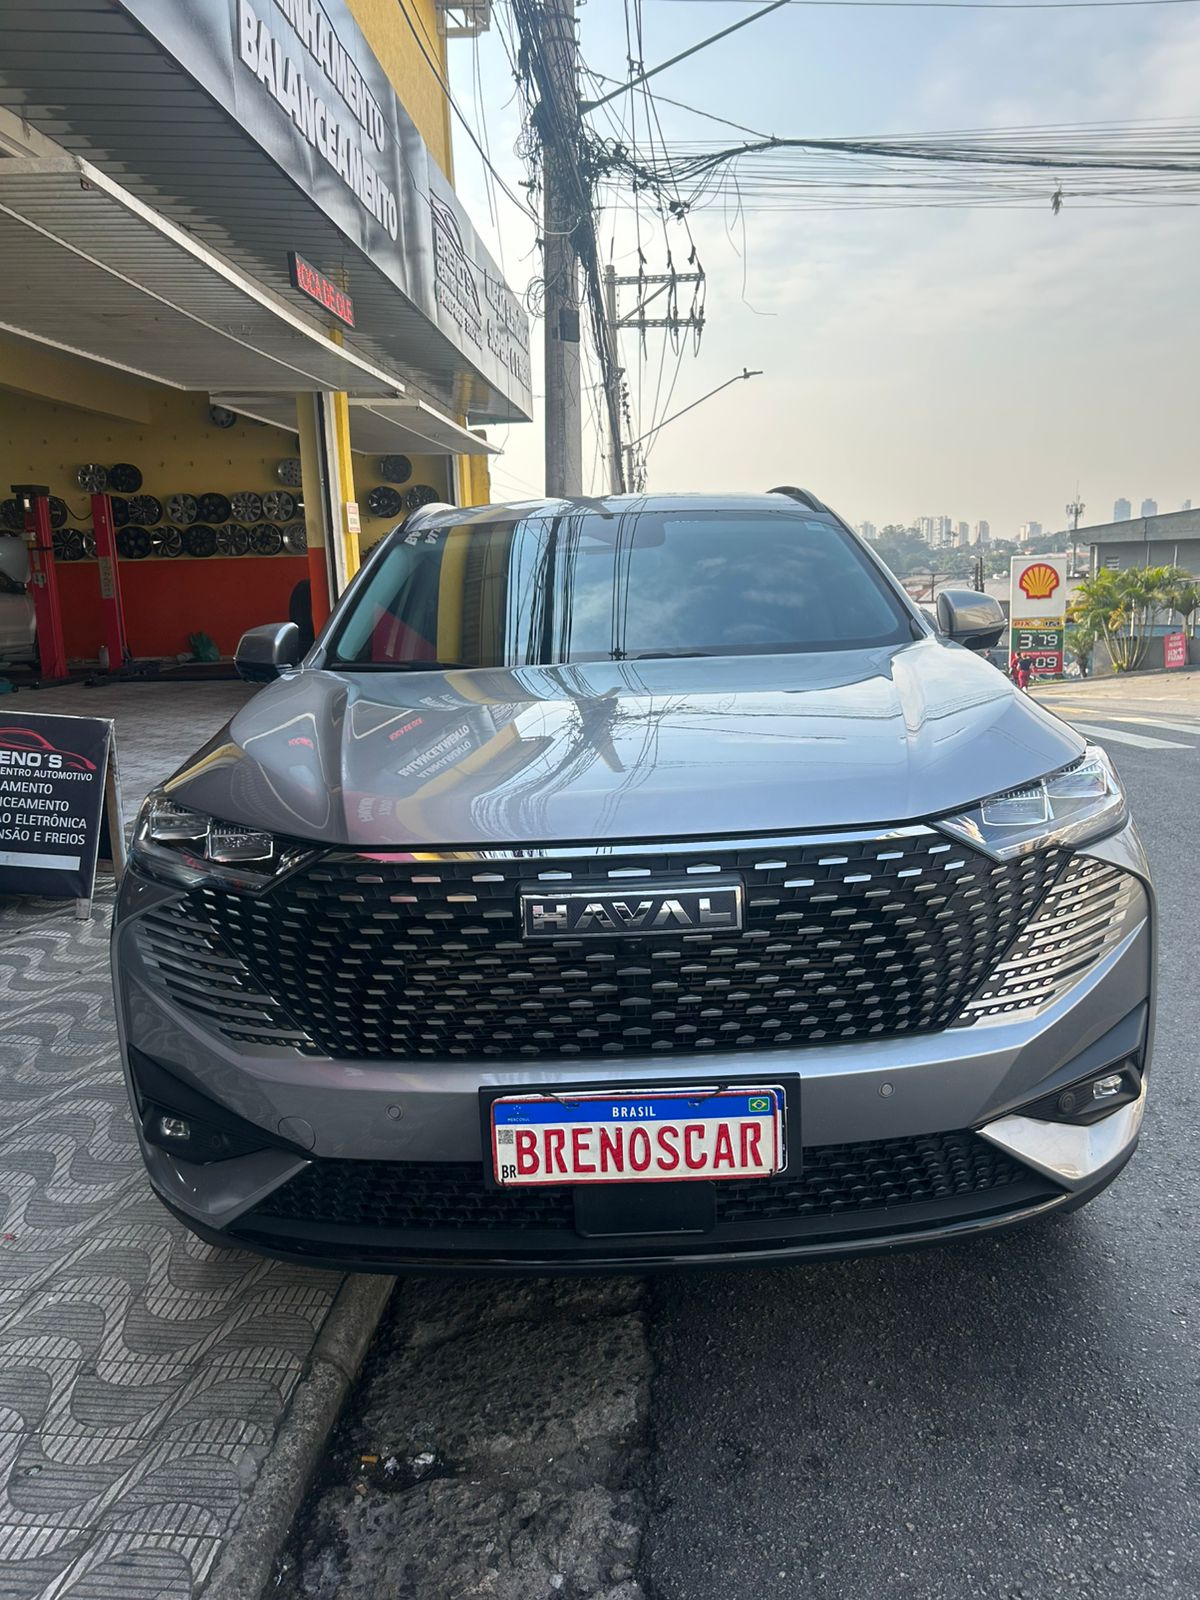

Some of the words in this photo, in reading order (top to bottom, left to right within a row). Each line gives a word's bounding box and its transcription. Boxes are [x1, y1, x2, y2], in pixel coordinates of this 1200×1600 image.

[237, 0, 397, 241] BALANCEAMENTO
[1019, 633, 1058, 649] 3.79
[0, 766, 32, 777] ENTRO
[33, 769, 93, 781] AUTOMOTIVO
[0, 796, 70, 812] CEAMENTO
[0, 812, 12, 824] O
[15, 813, 87, 829] ELETRÔNICA
[33, 831, 42, 842] E
[44, 832, 86, 845] FREIOS
[532, 897, 732, 930] HAVAL
[612, 1105, 657, 1118] BRASIL
[515, 1121, 764, 1175] BRENOSCAR
[501, 1164, 517, 1179] BR
